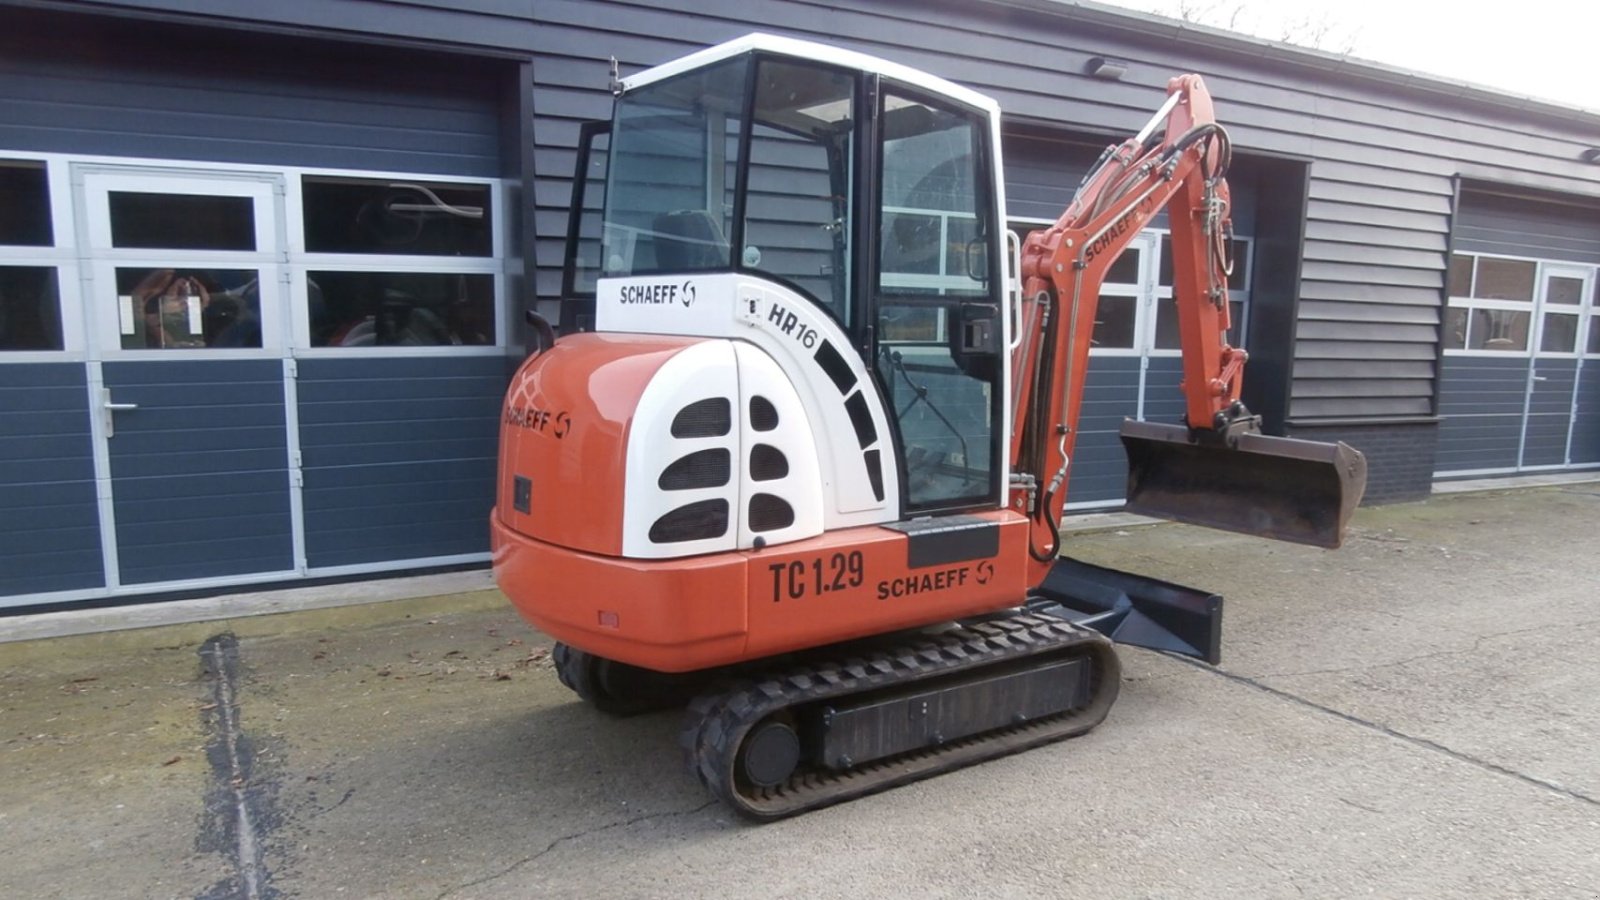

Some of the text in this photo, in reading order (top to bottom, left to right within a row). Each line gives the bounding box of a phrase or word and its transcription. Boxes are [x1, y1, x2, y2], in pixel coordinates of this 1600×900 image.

[619, 284, 678, 304] SCHAEFF
[768, 303, 818, 349] HR16
[769, 551, 864, 602] TC 1.29
[877, 568, 969, 600] SCHAEFF
